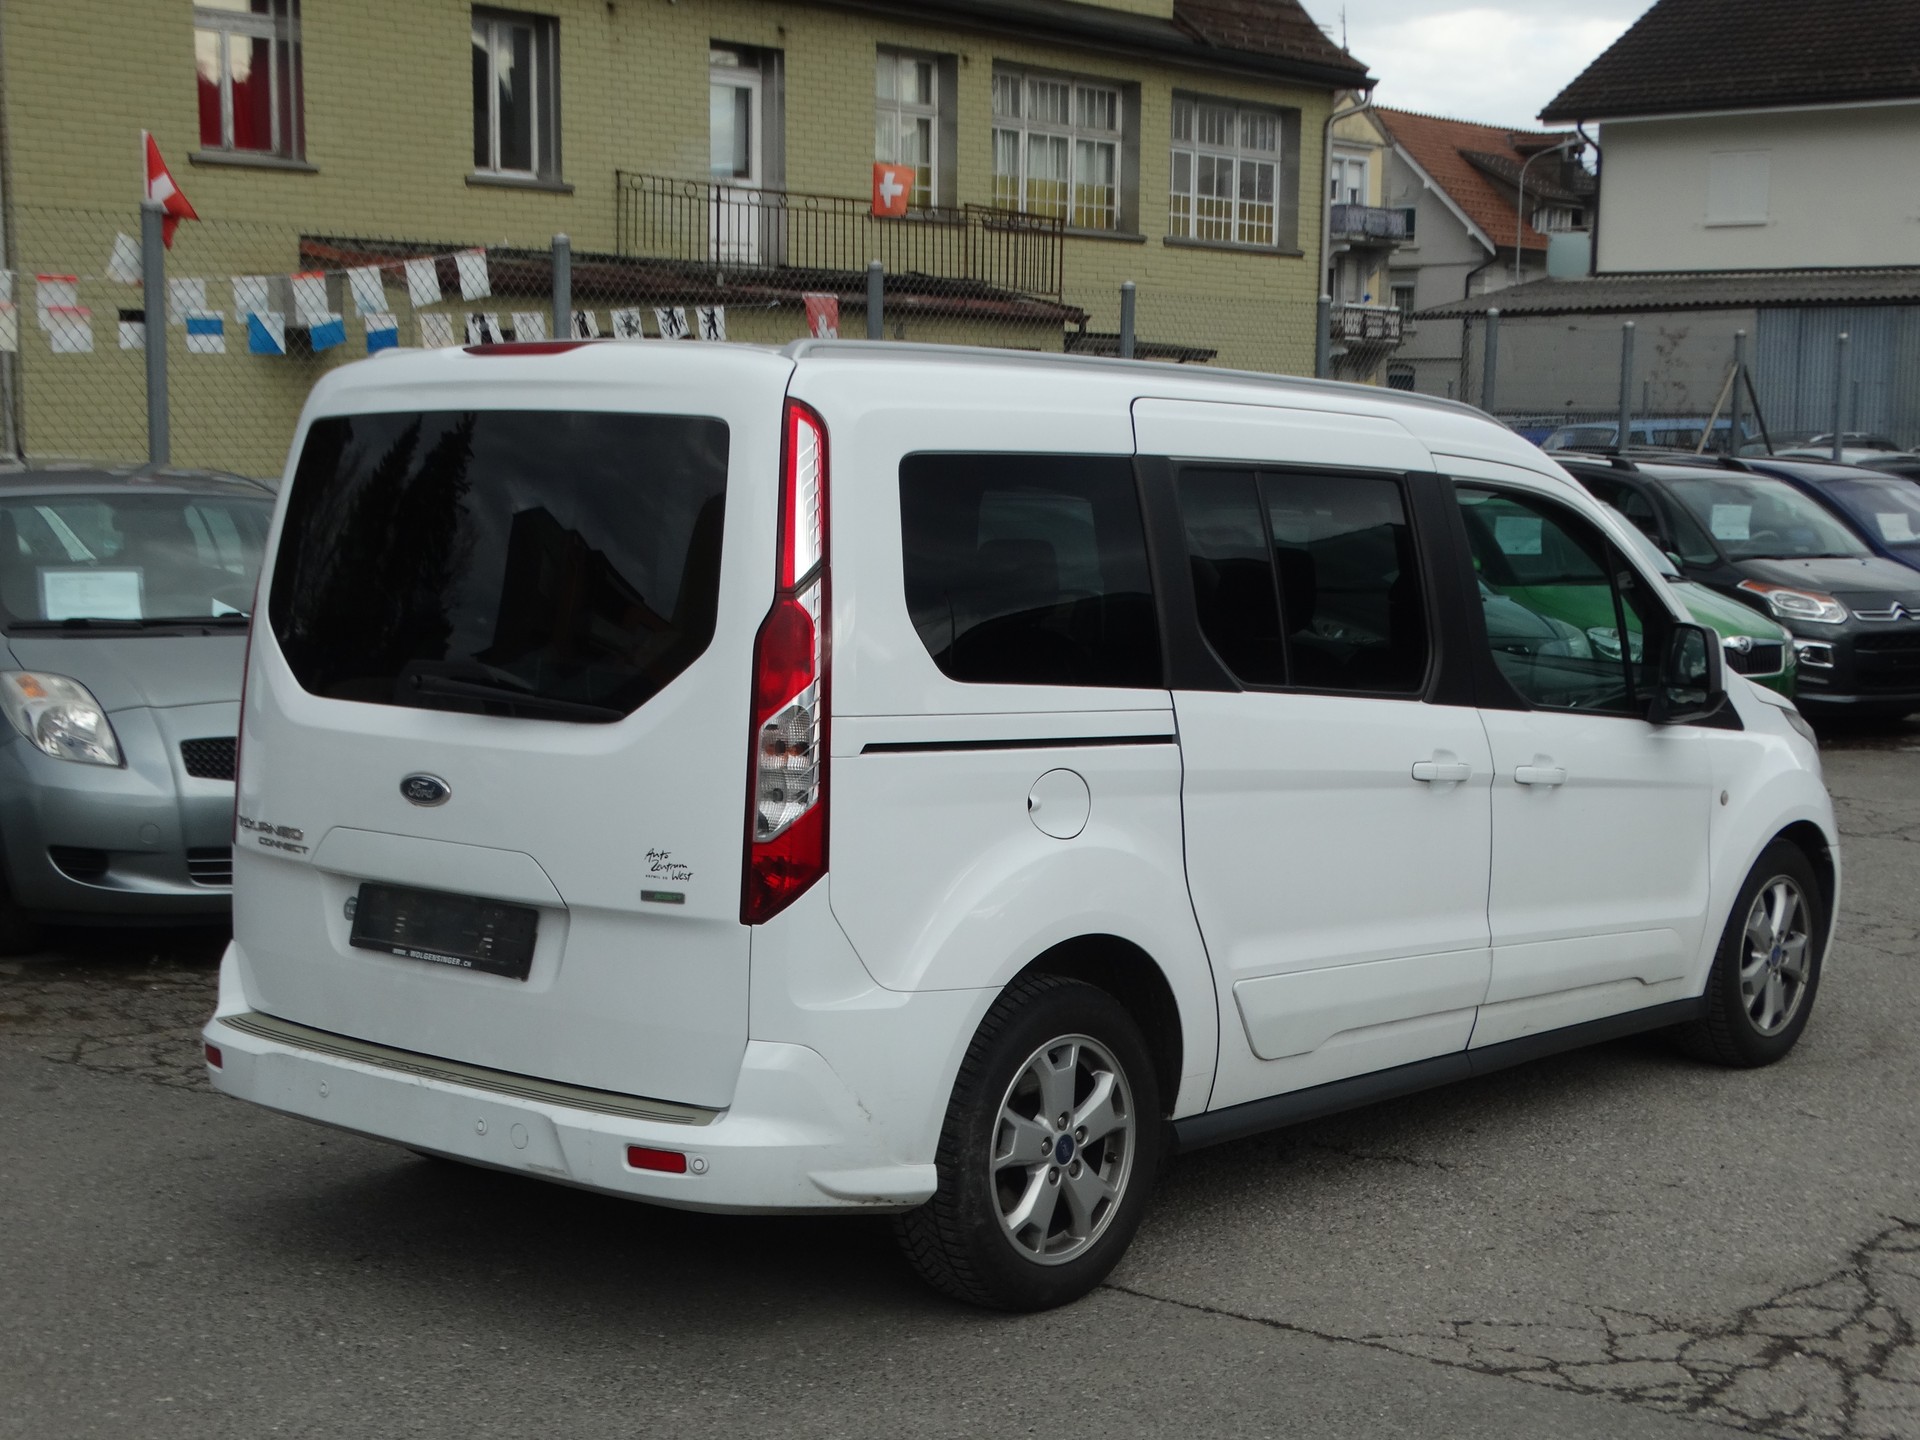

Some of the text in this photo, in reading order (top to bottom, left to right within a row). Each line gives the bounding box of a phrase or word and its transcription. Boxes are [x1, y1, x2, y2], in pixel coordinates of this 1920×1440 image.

[408, 780, 437, 799] Ford
[238, 815, 304, 841] TOURNEO
[258, 836, 309, 854] CONNECT
[644, 847, 672, 862] Auto
[651, 859, 688, 872] Zentrum
[671, 870, 694, 882] West
